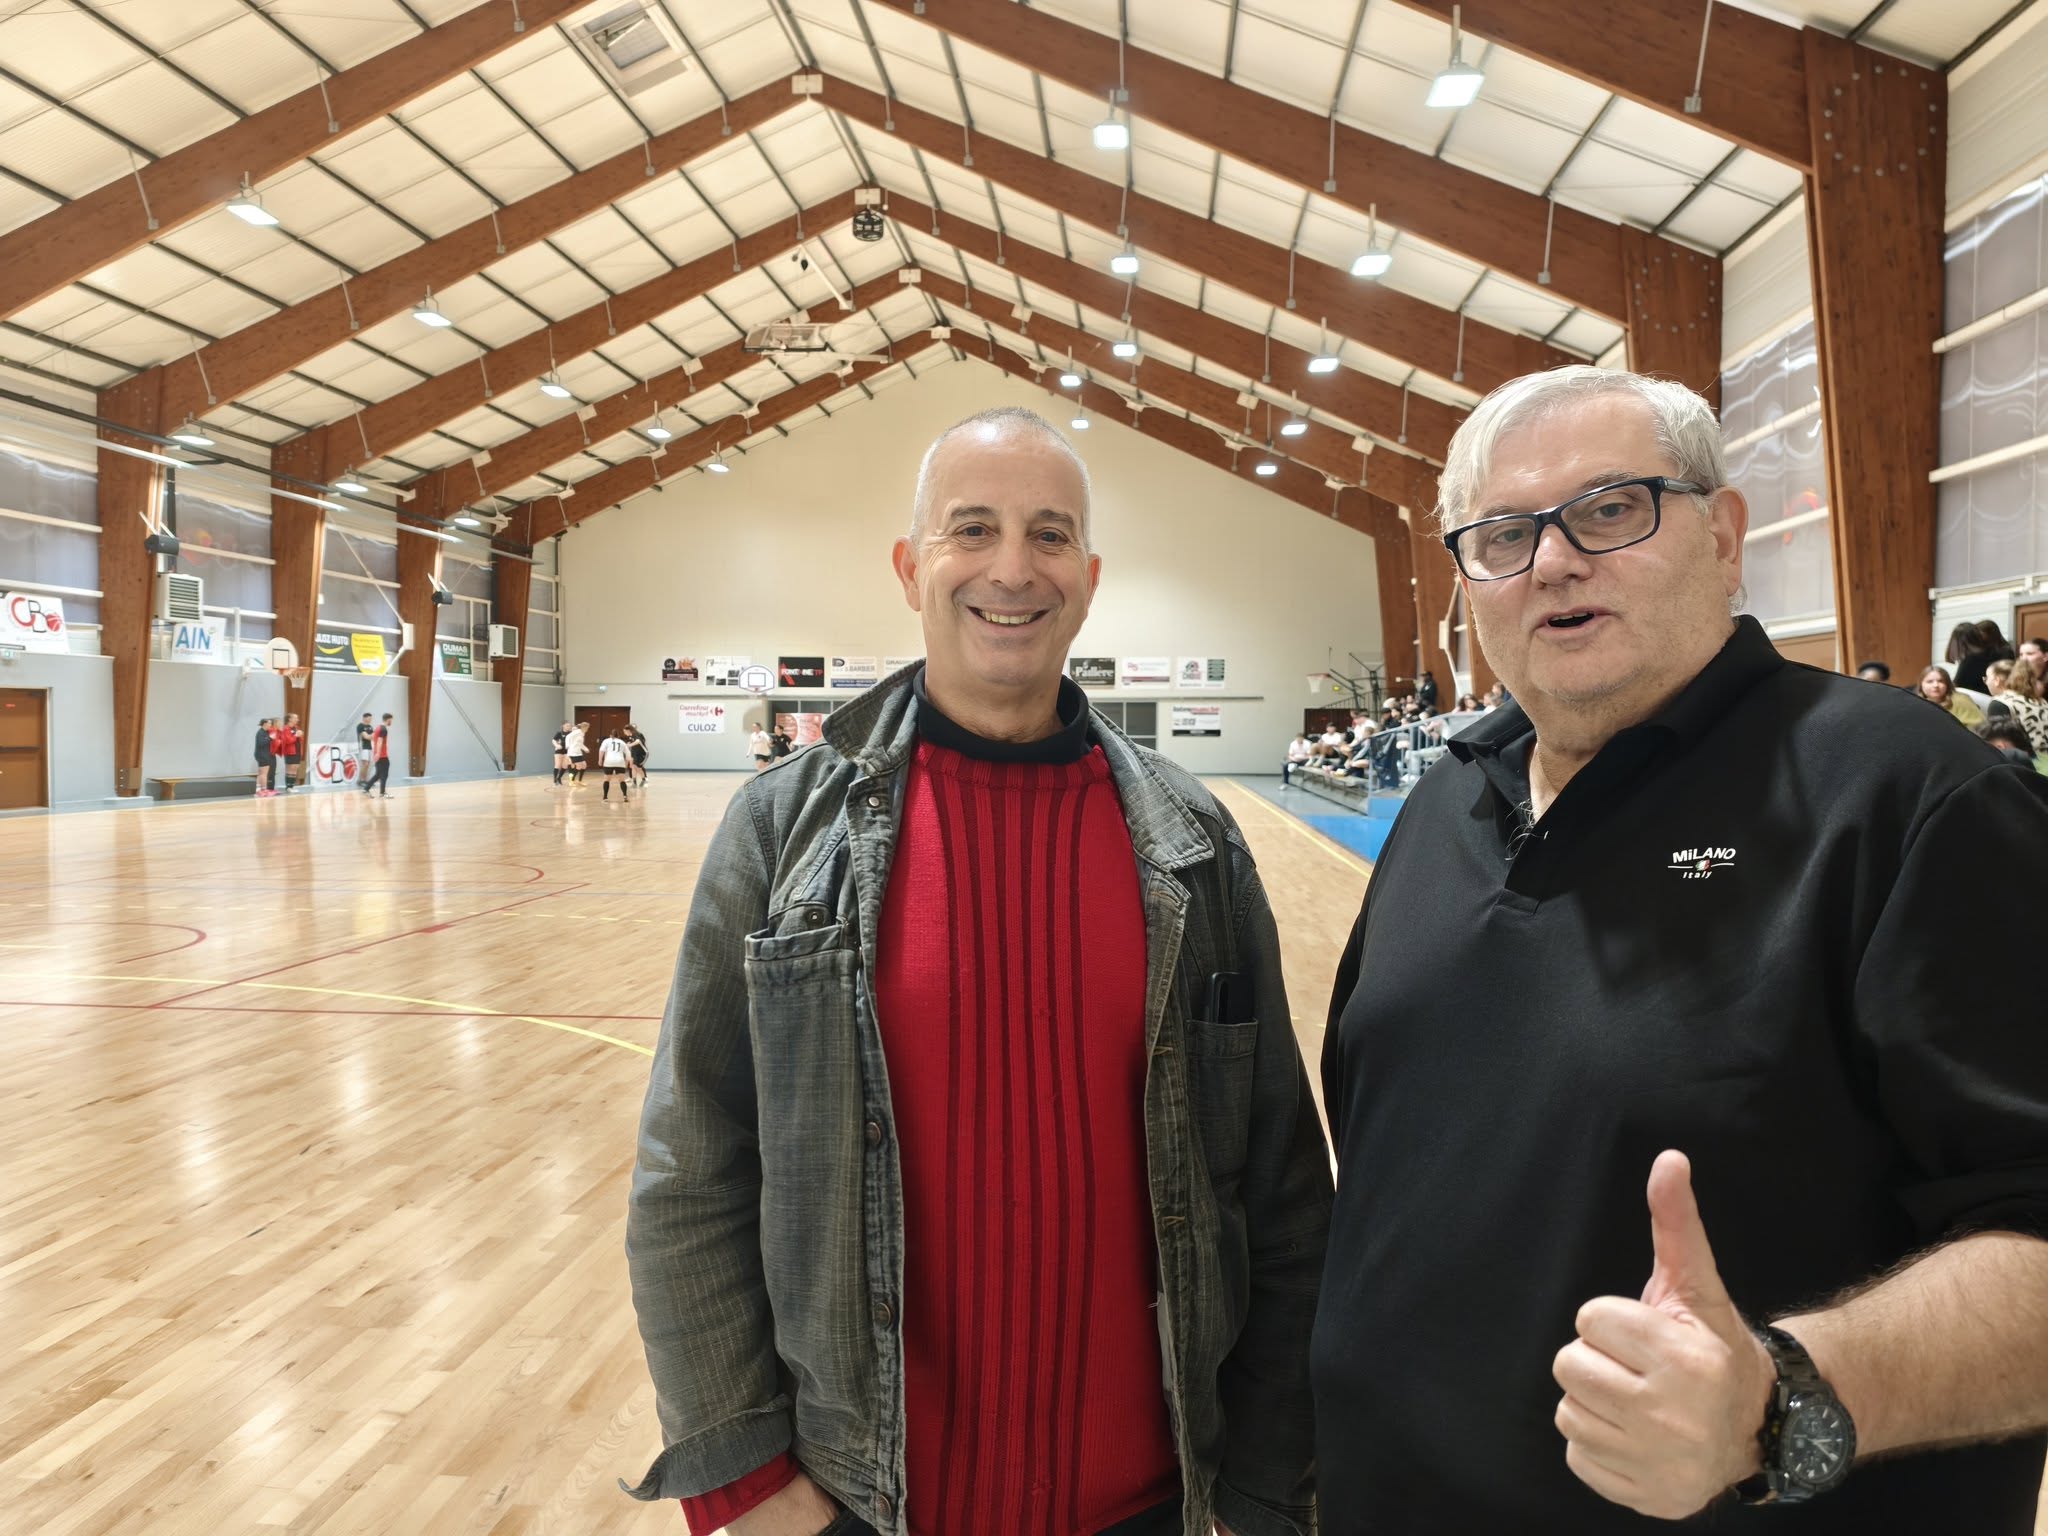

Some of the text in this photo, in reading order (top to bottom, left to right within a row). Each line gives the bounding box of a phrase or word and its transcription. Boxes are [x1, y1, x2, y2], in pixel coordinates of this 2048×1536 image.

[175, 626, 211, 650] AIN
[442, 643, 468, 654] DUMAS
[680, 703, 709, 711] Carrefour
[687, 723, 717, 732] CULOZ
[611, 741, 621, 752] 11
